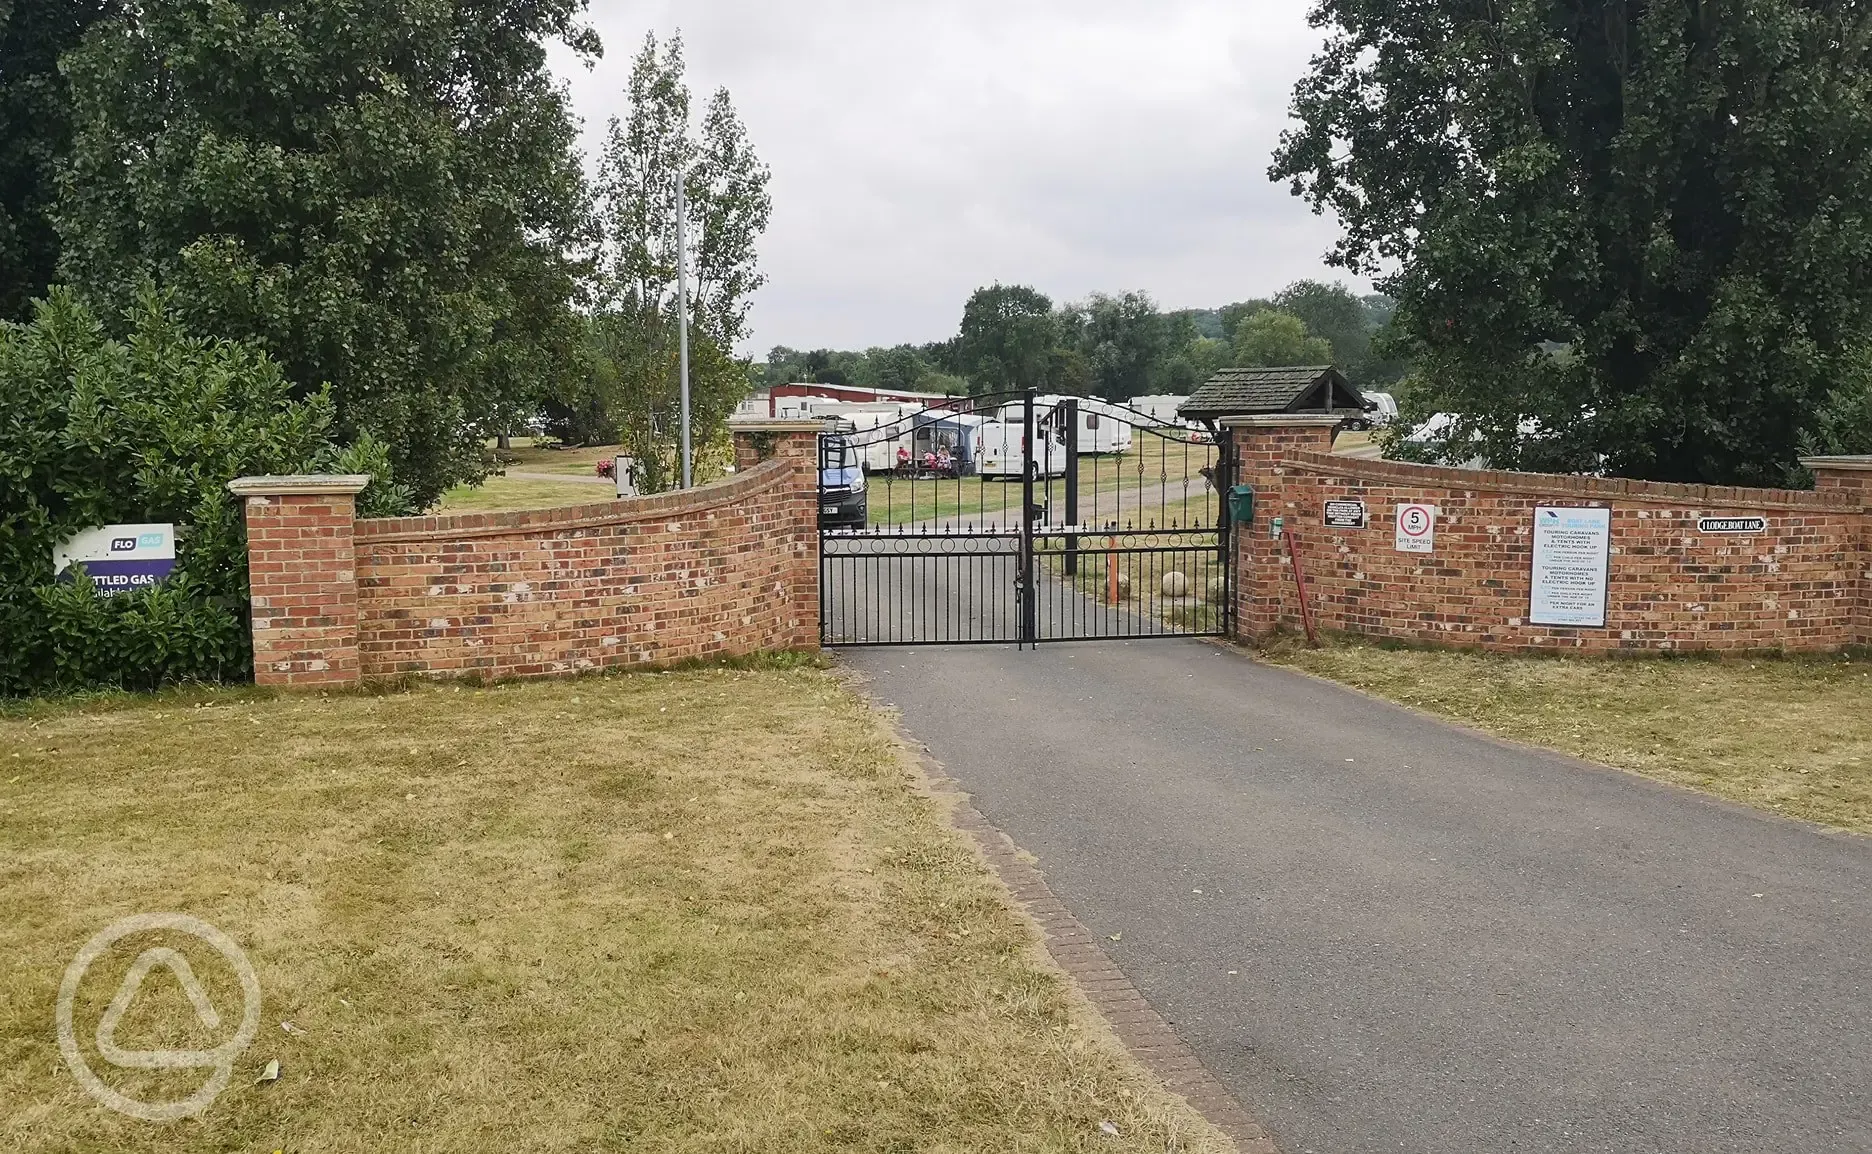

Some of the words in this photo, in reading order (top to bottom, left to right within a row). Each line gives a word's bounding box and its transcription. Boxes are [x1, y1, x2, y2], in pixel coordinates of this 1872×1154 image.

[1411, 512, 1419, 524] 5
[114, 540, 133, 549] FLO
[141, 536, 160, 544] GAS
[93, 576, 129, 585] TTLED
[130, 575, 154, 584] GAS
